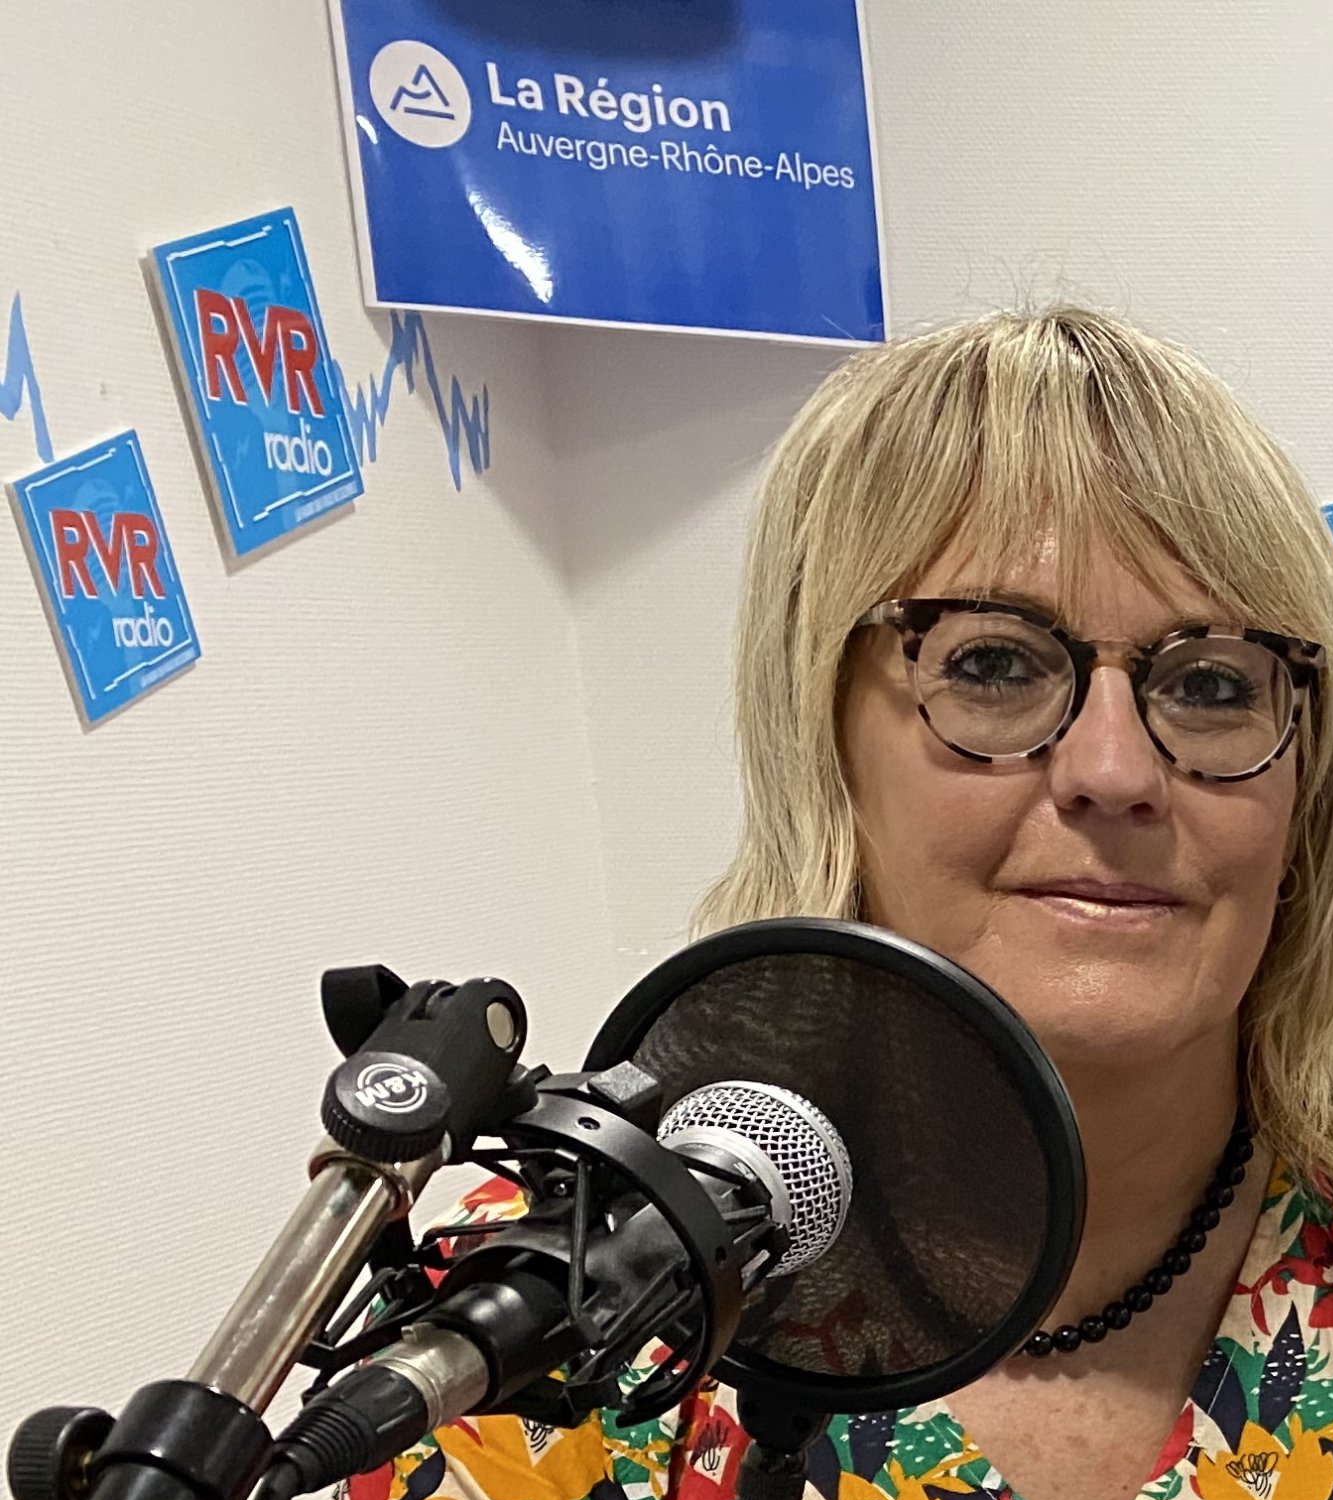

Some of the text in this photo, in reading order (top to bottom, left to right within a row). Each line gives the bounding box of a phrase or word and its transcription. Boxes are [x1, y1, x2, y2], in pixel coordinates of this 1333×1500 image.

[486, 62, 731, 132] La Région
[497, 121, 855, 189] Auvergne-Rhône-Alpes
[194, 288, 326, 419] RVR
[264, 417, 332, 476] radio
[49, 508, 167, 600] RVR
[112, 600, 173, 648] radio
[355, 1071, 428, 1107] K&M
